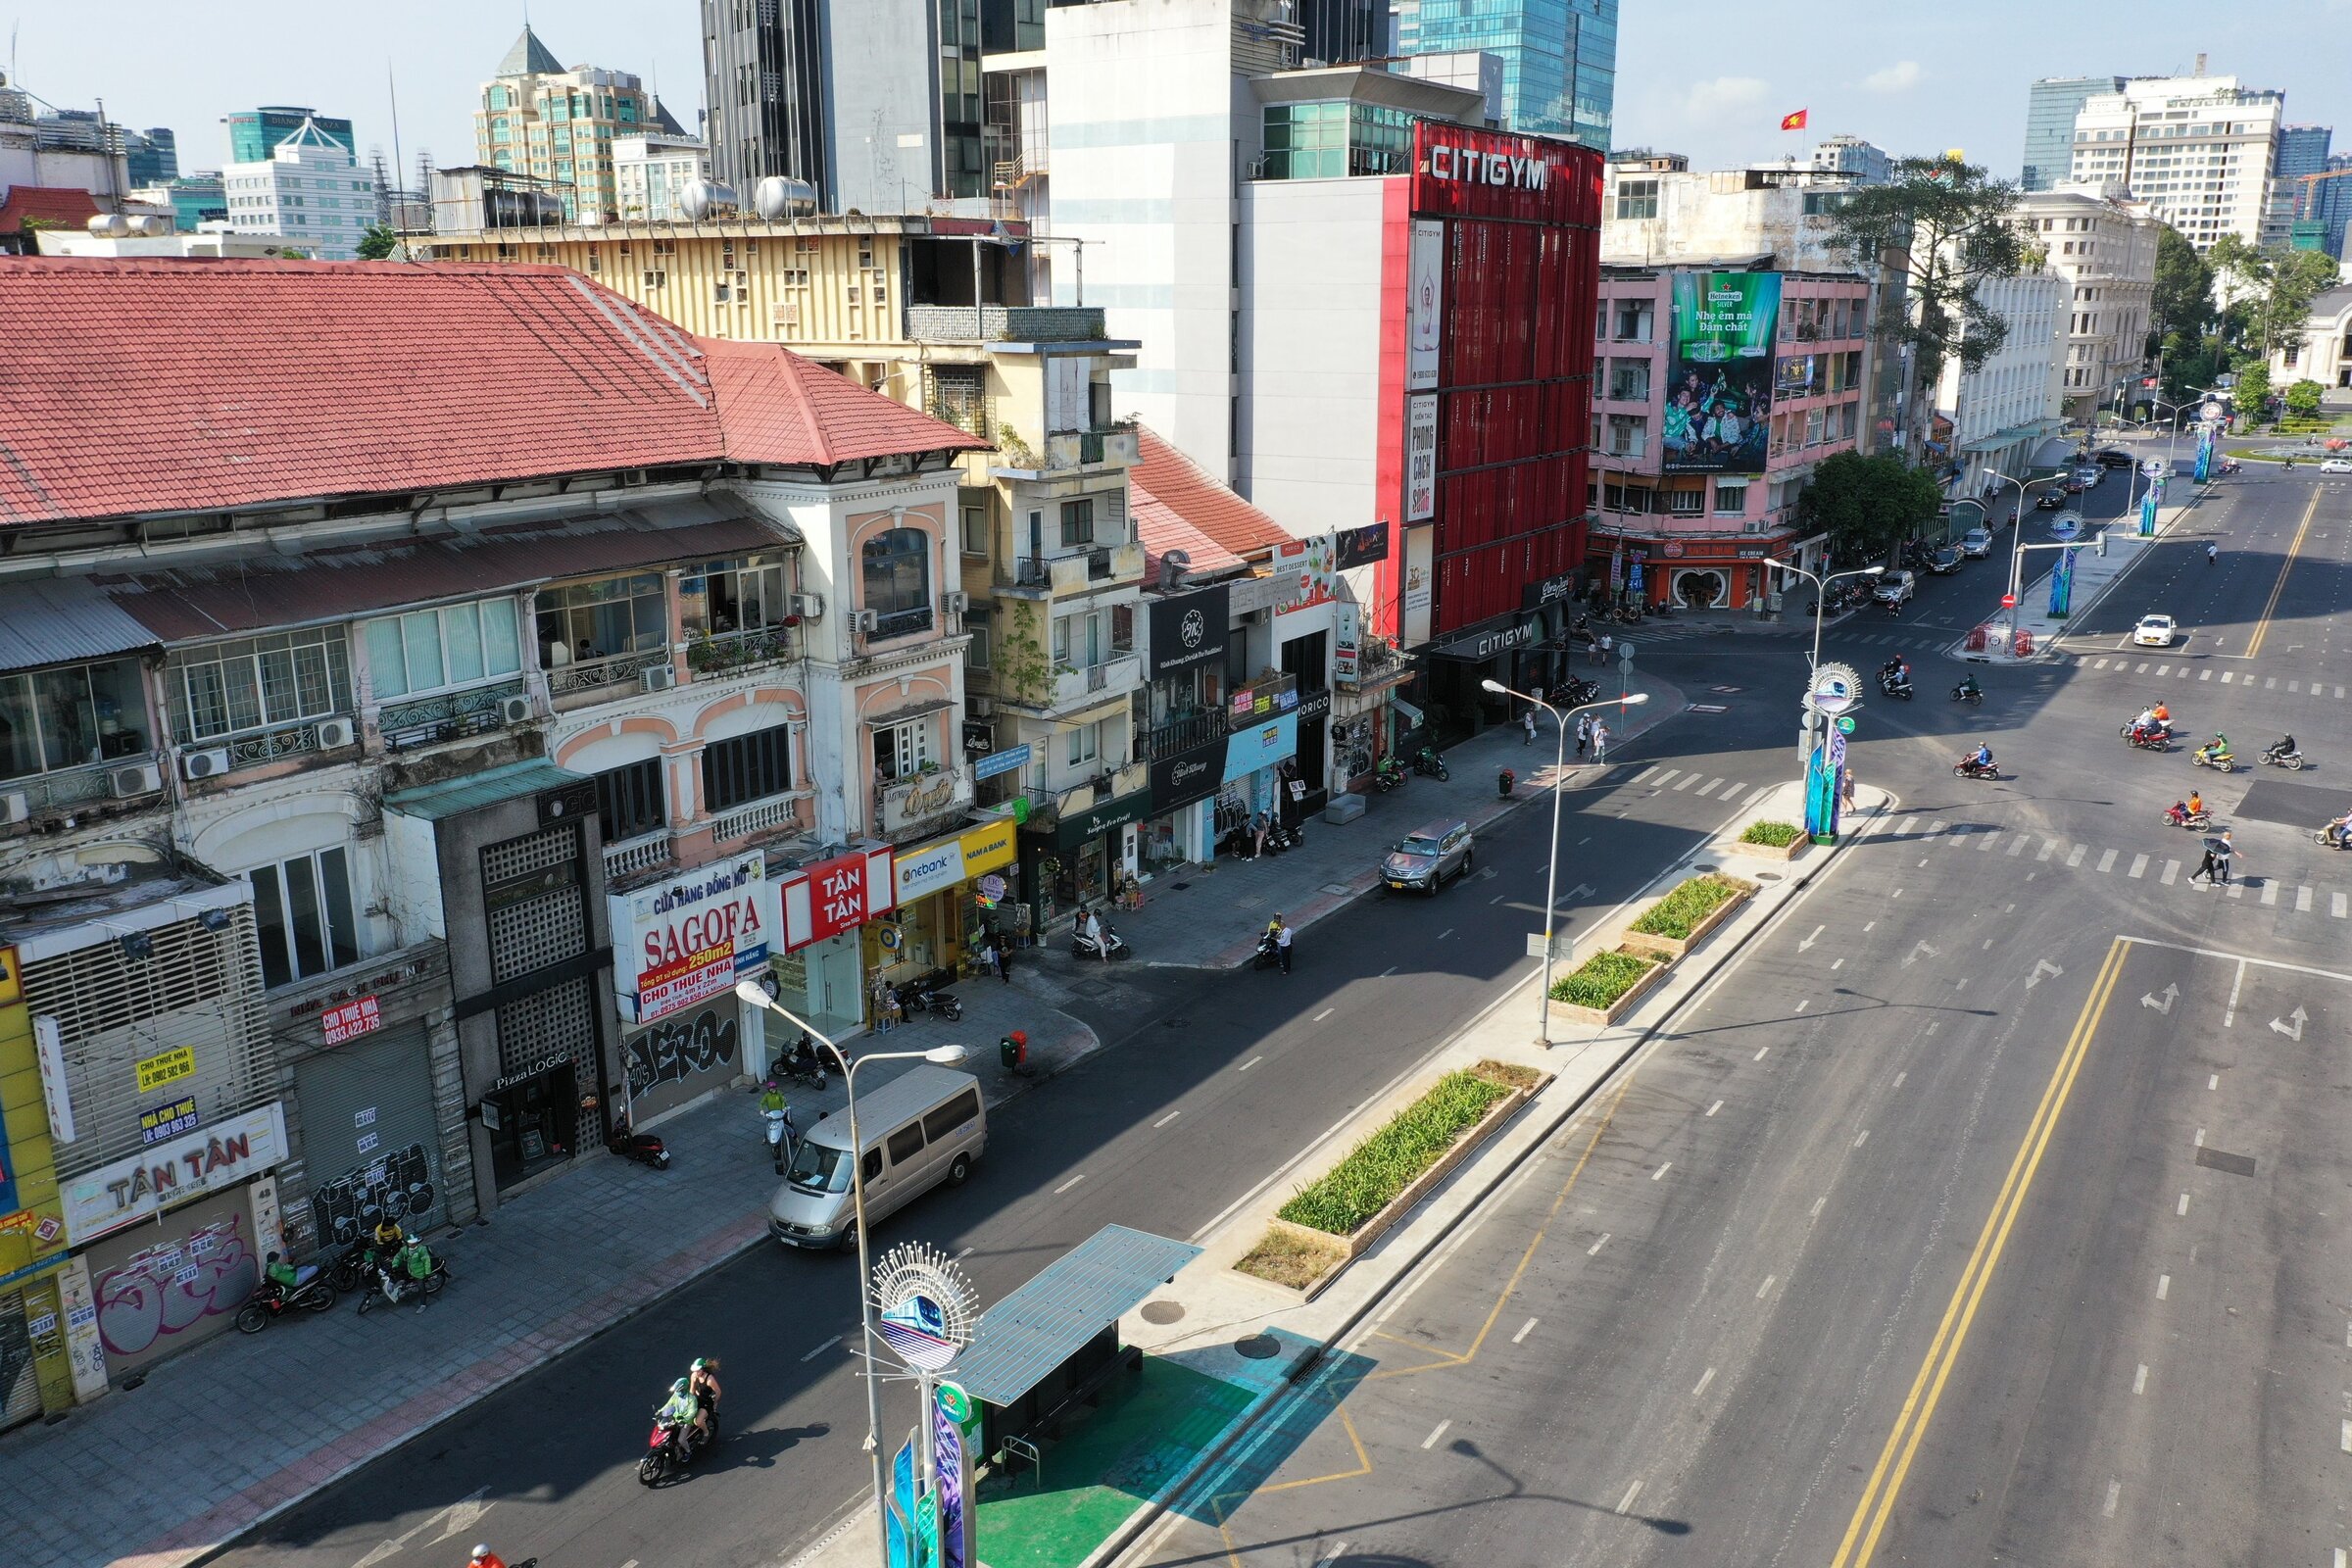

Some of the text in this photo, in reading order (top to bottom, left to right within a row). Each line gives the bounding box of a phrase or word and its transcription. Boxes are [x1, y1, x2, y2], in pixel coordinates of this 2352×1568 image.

[1432, 144, 1545, 191] CITIGYM
[1718, 311, 1735, 320] êm
[1725, 320, 1748, 331] chất
[1412, 425, 1434, 451] PHONG
[1413, 451, 1431, 480] CÁCH
[1276, 560, 1307, 573] BEST DESSERT
[1478, 623, 1533, 656] CITIGYM
[966, 849, 983, 860] NAM
[989, 839, 1007, 852] BANK
[823, 868, 860, 898] TÂN
[823, 894, 861, 923] TÂN
[644, 895, 760, 970] SAGOFA
[656, 974, 663, 983] DT
[689, 941, 732, 969] 250m2
[643, 986, 668, 1004] CHO
[672, 970, 703, 992] THUÊ
[707, 959, 731, 979] NHÀ
[703, 978, 717, 989] 22m
[322, 996, 378, 1030] CHO THUÊ NHÀ
[661, 1004, 676, 1014] 0975
[325, 1014, 380, 1045] 0933.422.735
[38, 1027, 52, 1078] TÂN
[140, 1050, 188, 1072] CHO THUÊ NHÀ
[497, 1070, 527, 1090] Pizza
[141, 1097, 195, 1130] NHÀ CHO THUÊ
[154, 1124, 171, 1140] 0903
[184, 1112, 196, 1128] 325
[107, 1132, 250, 1208] TÂN TÂN
